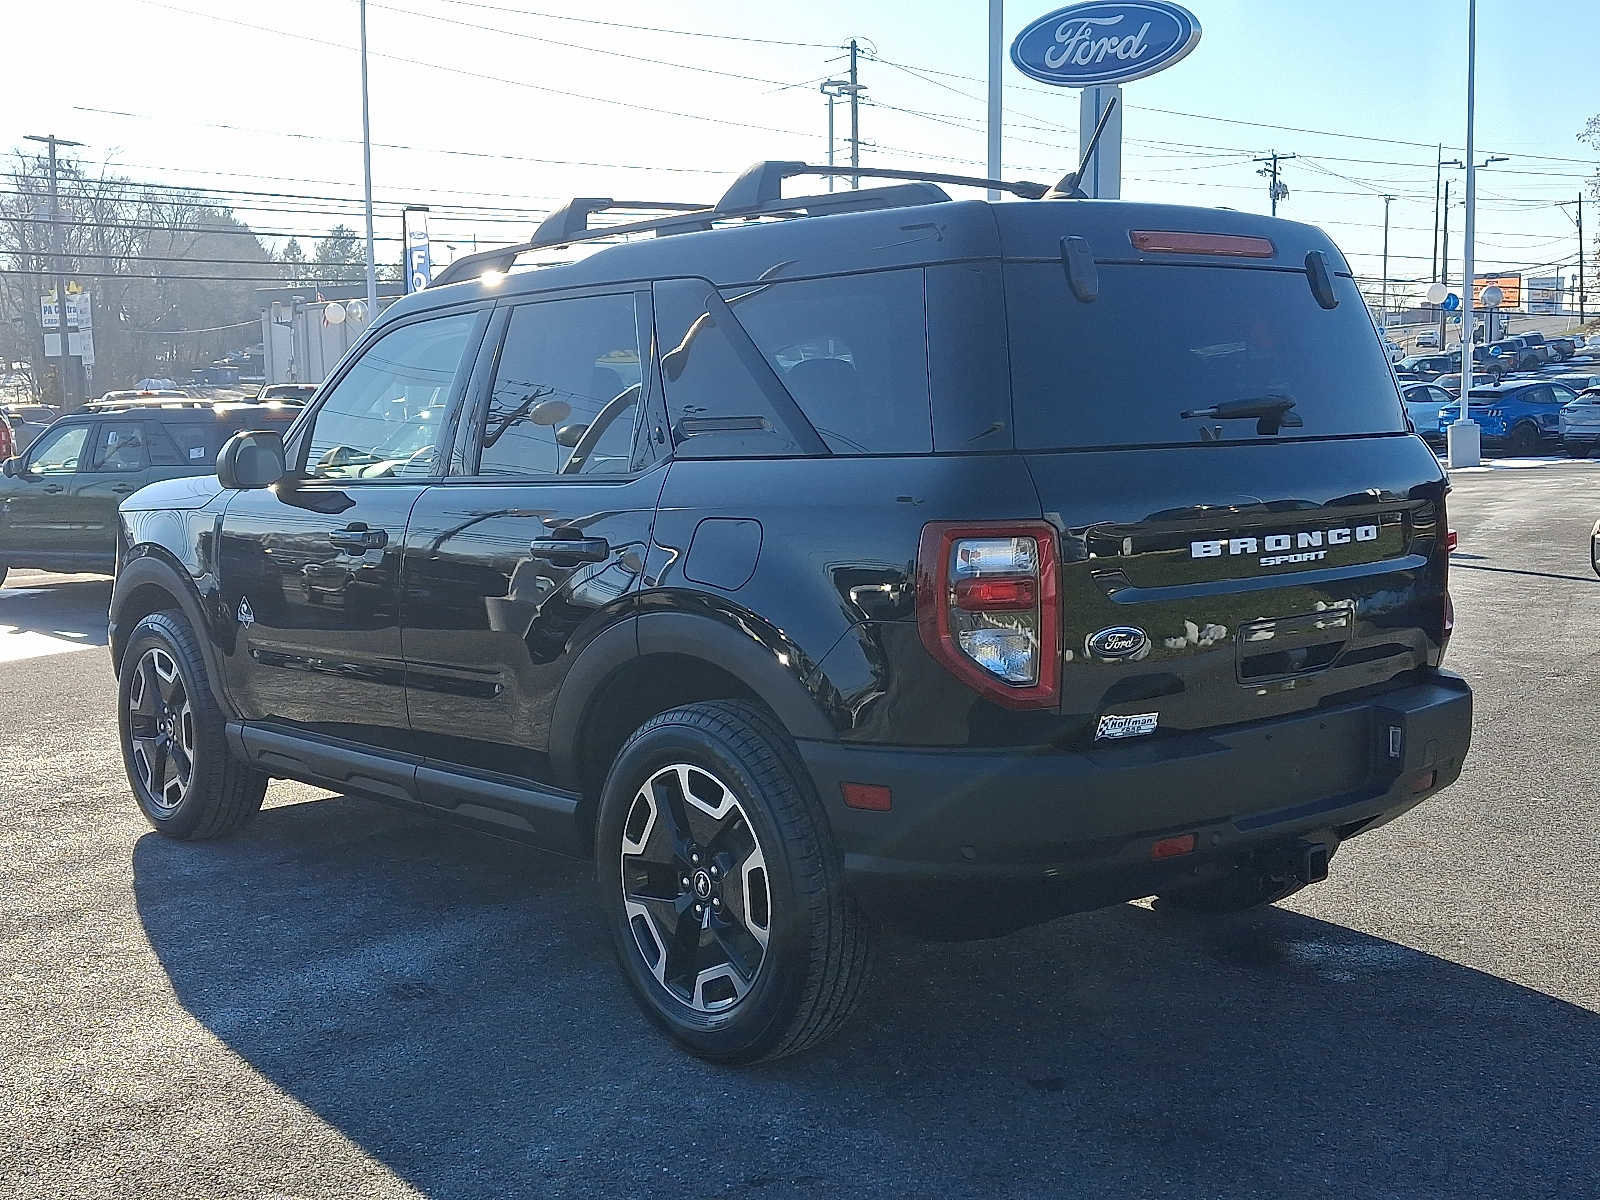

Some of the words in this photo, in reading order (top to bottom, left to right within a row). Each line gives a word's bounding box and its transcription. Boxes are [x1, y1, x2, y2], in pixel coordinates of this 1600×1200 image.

[1045, 14, 1151, 69] Ford
[412, 249, 427, 291] FO
[1191, 525, 1377, 557] BRONCO
[1259, 550, 1328, 567] SPORT
[1105, 633, 1135, 650] Ford
[1110, 718, 1153, 729] Hoffman
